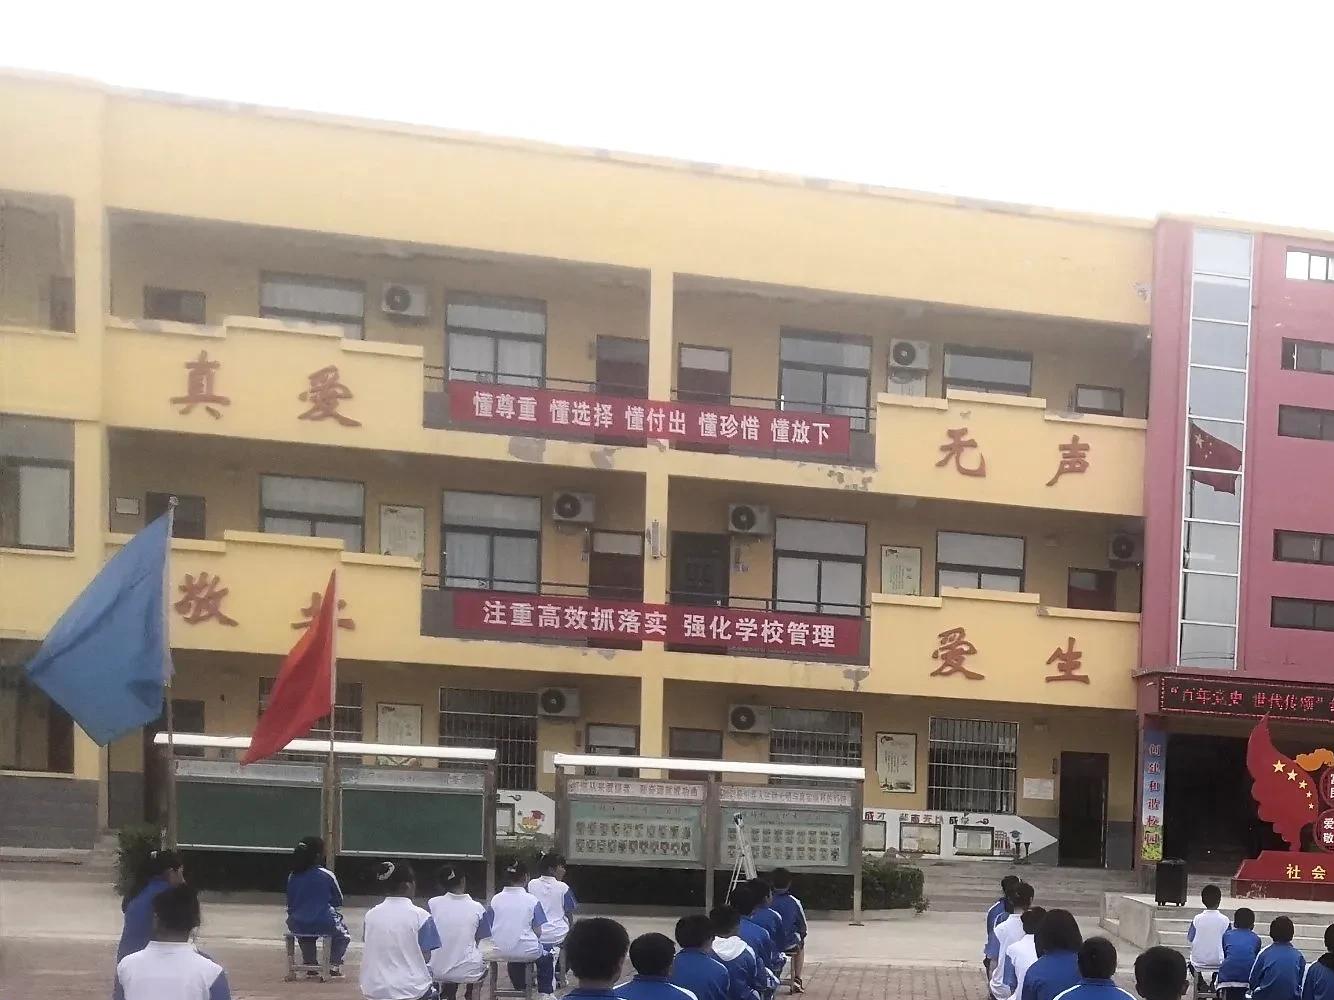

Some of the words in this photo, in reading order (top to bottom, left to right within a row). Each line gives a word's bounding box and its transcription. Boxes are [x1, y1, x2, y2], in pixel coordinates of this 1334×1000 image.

[170, 349, 362, 427] 真爱
[472, 390, 537, 422] 懂尊重
[550, 398, 614, 429] 懂选择
[624, 405, 687, 436] 懂付出
[698, 411, 760, 442] 懂珍惜
[770, 416, 832, 446] 懂放下
[935, 427, 1091, 487] 无声
[483, 600, 668, 636] 注重高效抓落实
[683, 613, 836, 649] 强化学校管理
[930, 626, 1091, 685] 爱生
